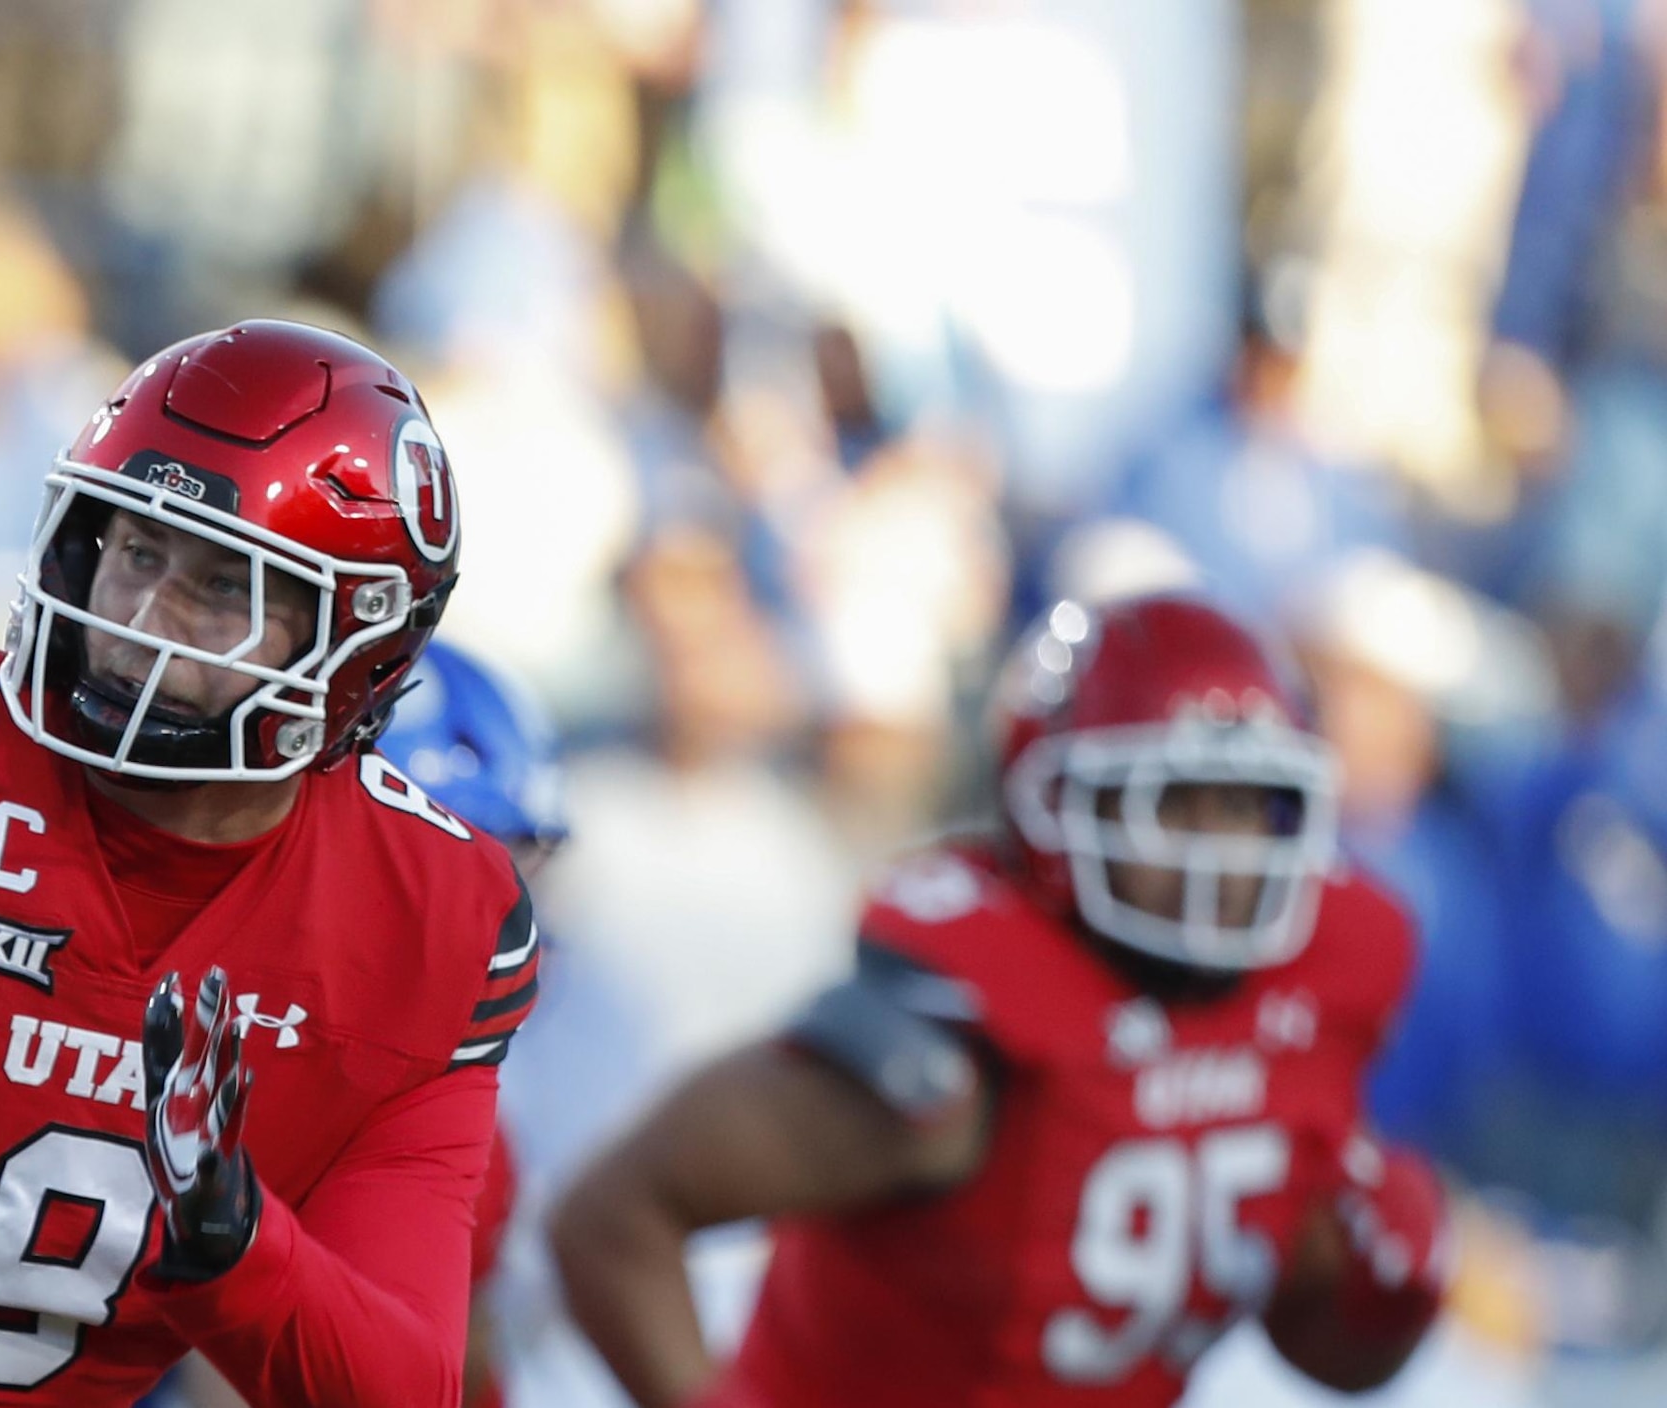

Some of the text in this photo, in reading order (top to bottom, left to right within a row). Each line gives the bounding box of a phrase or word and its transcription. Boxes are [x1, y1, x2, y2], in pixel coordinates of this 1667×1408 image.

[403, 440, 451, 549] U
[3, 1014, 147, 1111] UTA
[1041, 1122, 1291, 1386] 95
